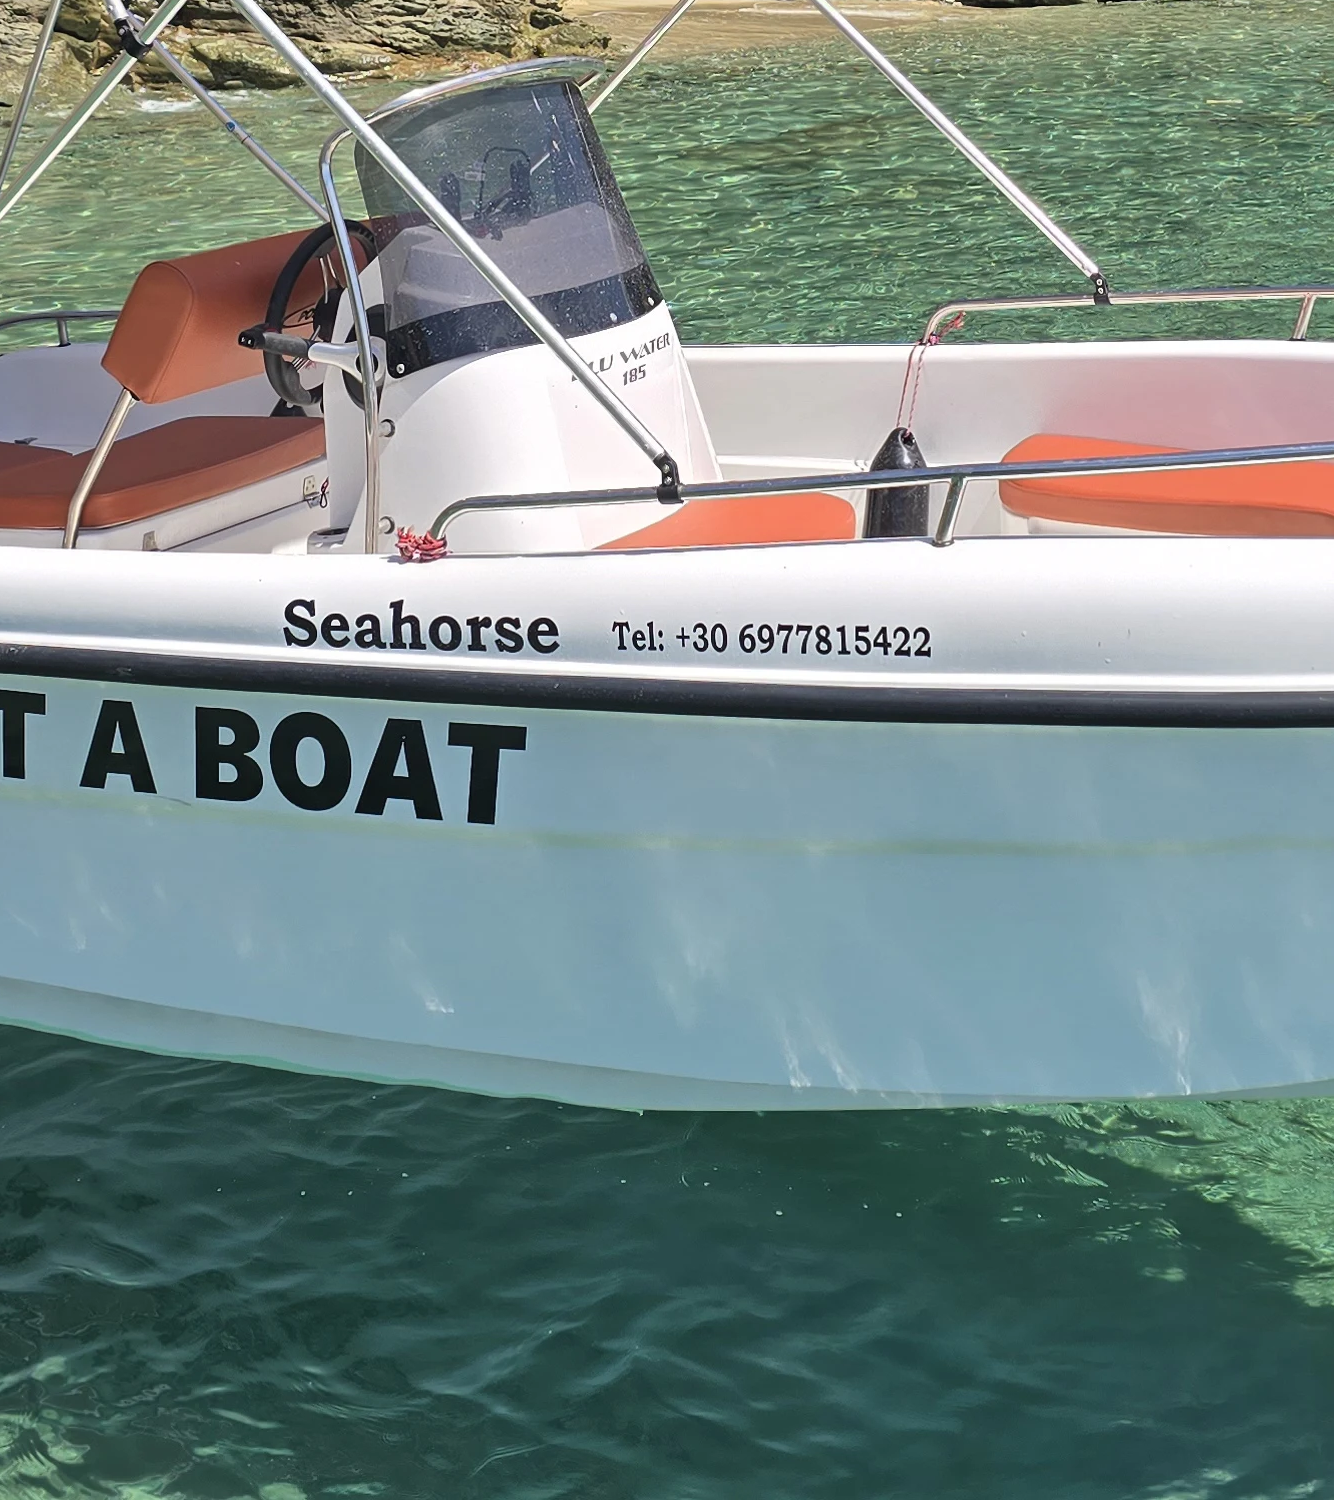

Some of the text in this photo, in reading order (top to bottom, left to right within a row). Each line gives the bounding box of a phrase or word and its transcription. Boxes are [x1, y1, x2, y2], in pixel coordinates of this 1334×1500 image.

[571, 332, 671, 383] LU WATER
[622, 363, 647, 387] 185
[282, 598, 560, 654] Seahorse
[611, 620, 932, 658] Tel: +30 6977815422
[79, 699, 158, 794] A
[195, 705, 528, 825] BOAT
